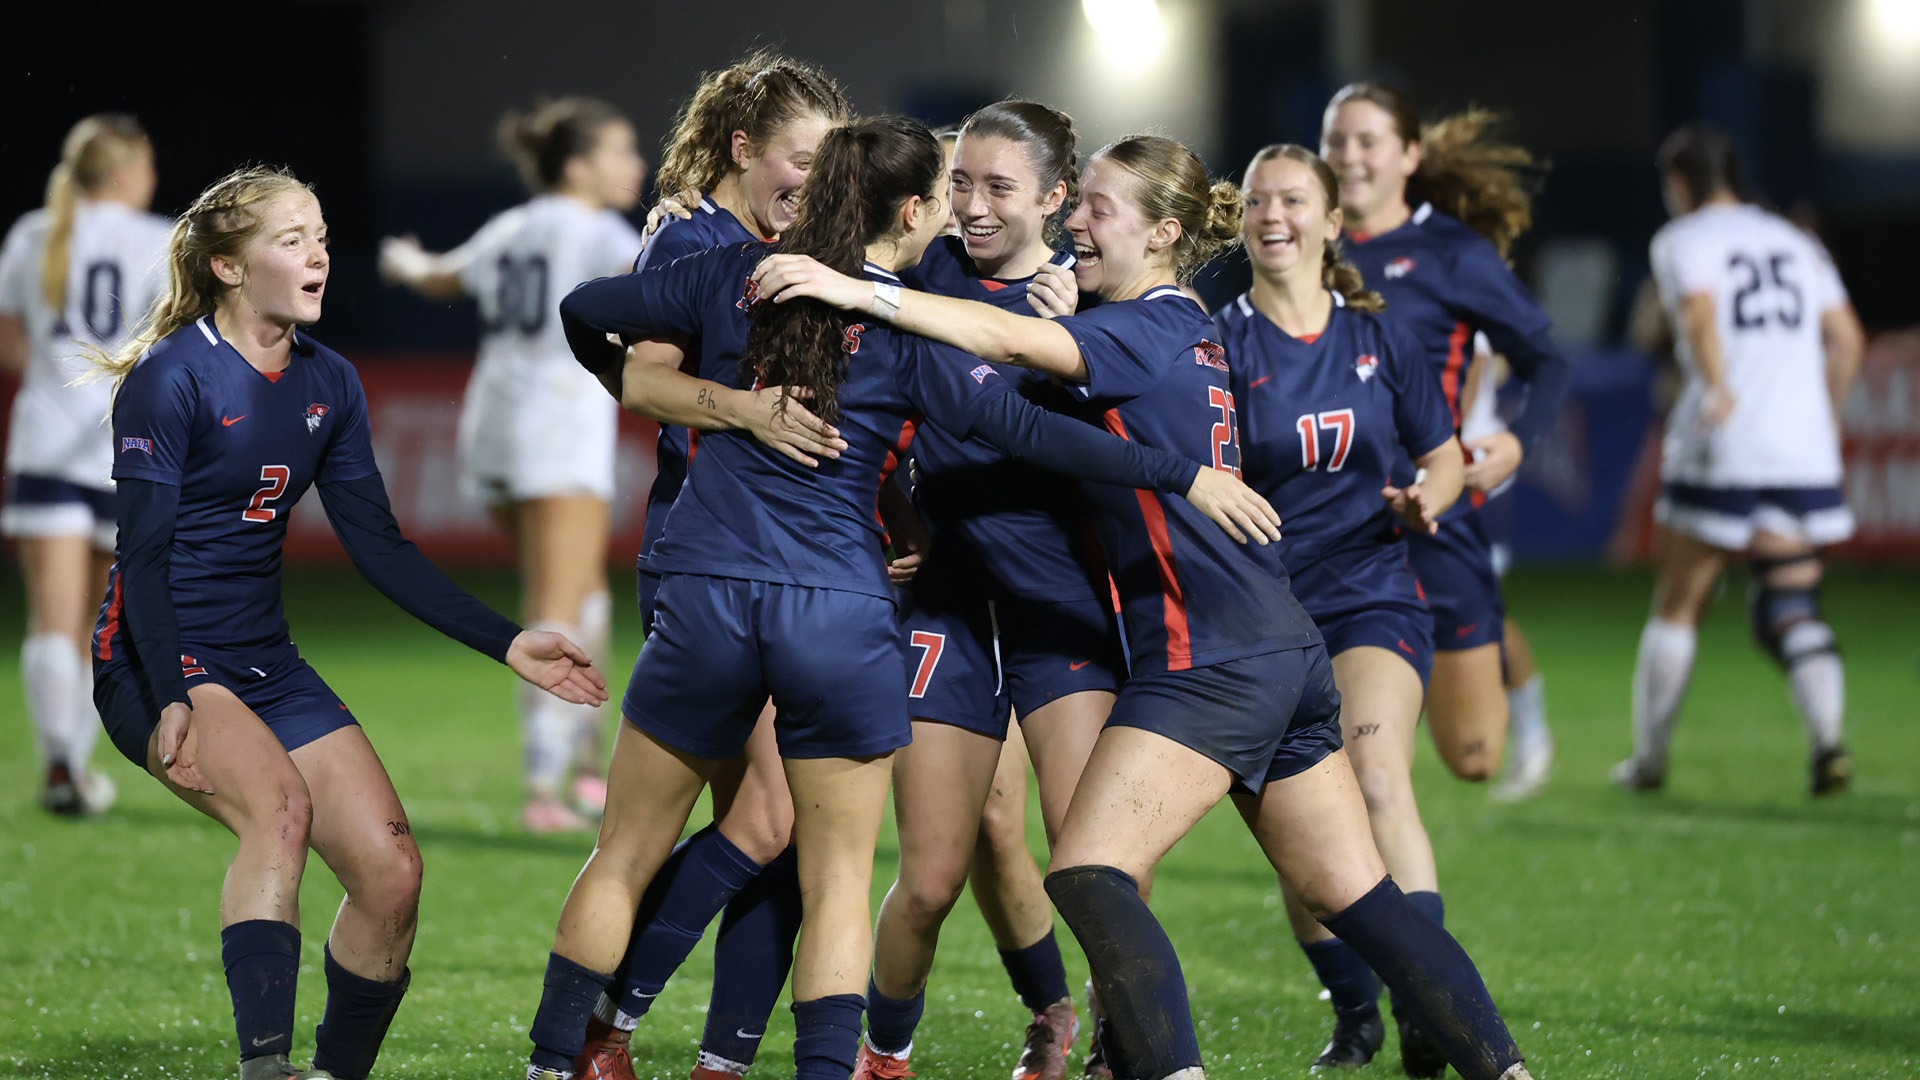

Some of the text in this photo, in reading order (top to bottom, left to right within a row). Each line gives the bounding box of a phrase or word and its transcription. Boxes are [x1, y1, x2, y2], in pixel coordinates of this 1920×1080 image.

[1728, 251, 1803, 332] 25
[121, 437, 153, 455] NAIA
[1296, 408, 1356, 473] 17
[241, 464, 291, 523] 2
[909, 630, 946, 699] 7
[1351, 722, 1381, 740] JOY
